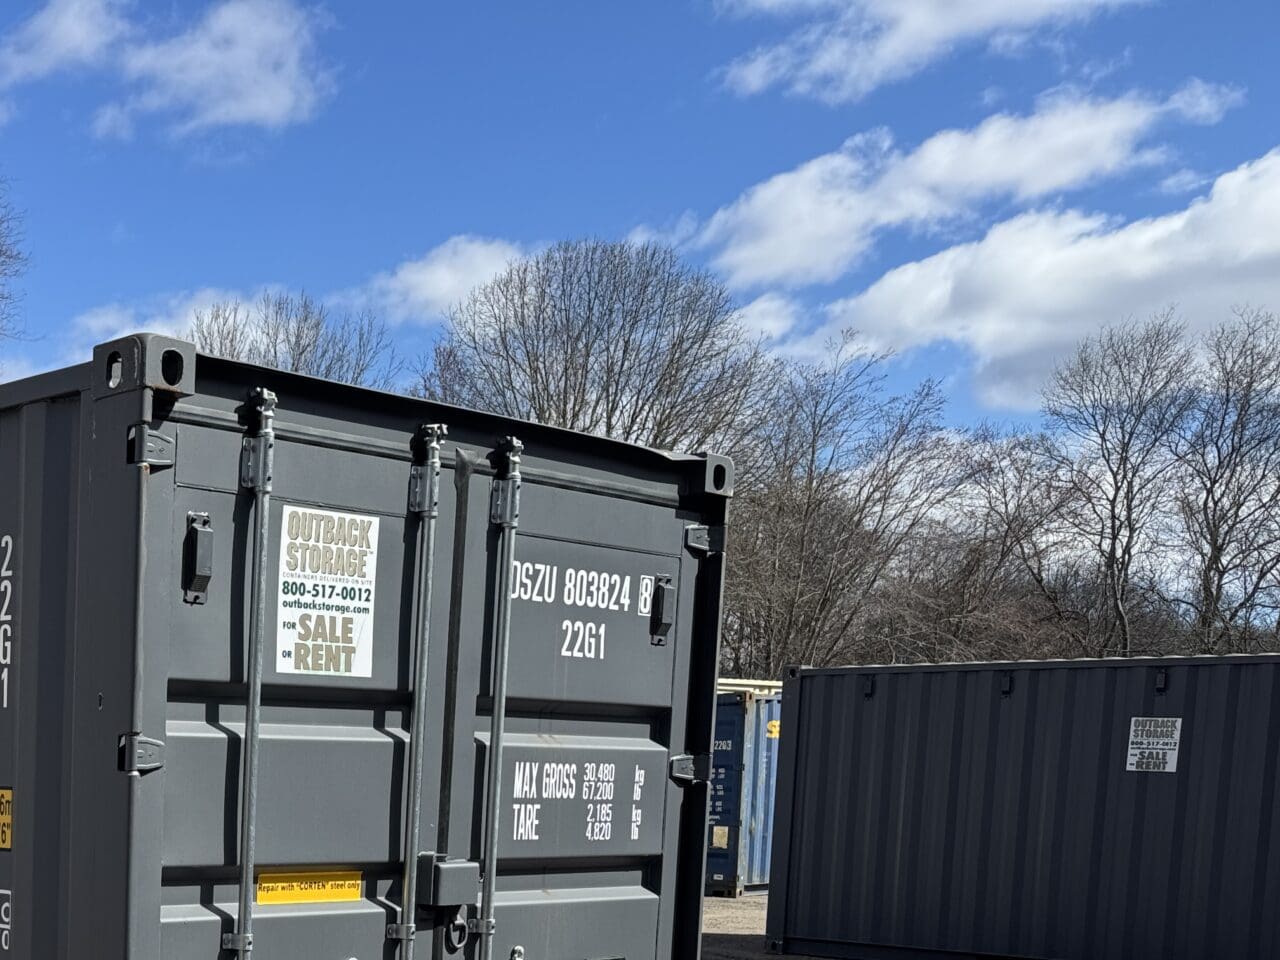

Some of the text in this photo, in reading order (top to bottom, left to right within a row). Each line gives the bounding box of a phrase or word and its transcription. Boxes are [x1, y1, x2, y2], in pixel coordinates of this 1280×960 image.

[288, 510, 372, 549] OUTBACK
[286, 541, 368, 578] STORAGE
[282, 572, 318, 581] CONTAINERS
[319, 575, 349, 584] DELIVERED
[511, 560, 653, 615] DSZU 803824 8
[282, 581, 372, 602] 800-517-0012
[282, 598, 370, 614] outbackstorage.com
[0, 535, 13, 708] 22G1
[283, 613, 354, 644] FOR SALE
[561, 620, 606, 660] 22G1
[282, 642, 356, 673] OR RENT
[1133, 729, 1175, 738] STORAGE
[1134, 719, 1177, 729] OUTBACK
[1135, 760, 1168, 770] RENT
[1138, 751, 1167, 760] SALE
[513, 762, 539, 799] MAX
[542, 762, 577, 799] GROSS
[634, 764, 645, 786] kg
[633, 783, 641, 800] lb
[513, 804, 540, 840] TARE
[632, 804, 641, 825] kg
[631, 822, 639, 840] lb
[258, 883, 279, 893] Repair
[281, 883, 294, 891] with
[331, 881, 345, 890] steel
[347, 880, 360, 890] only
